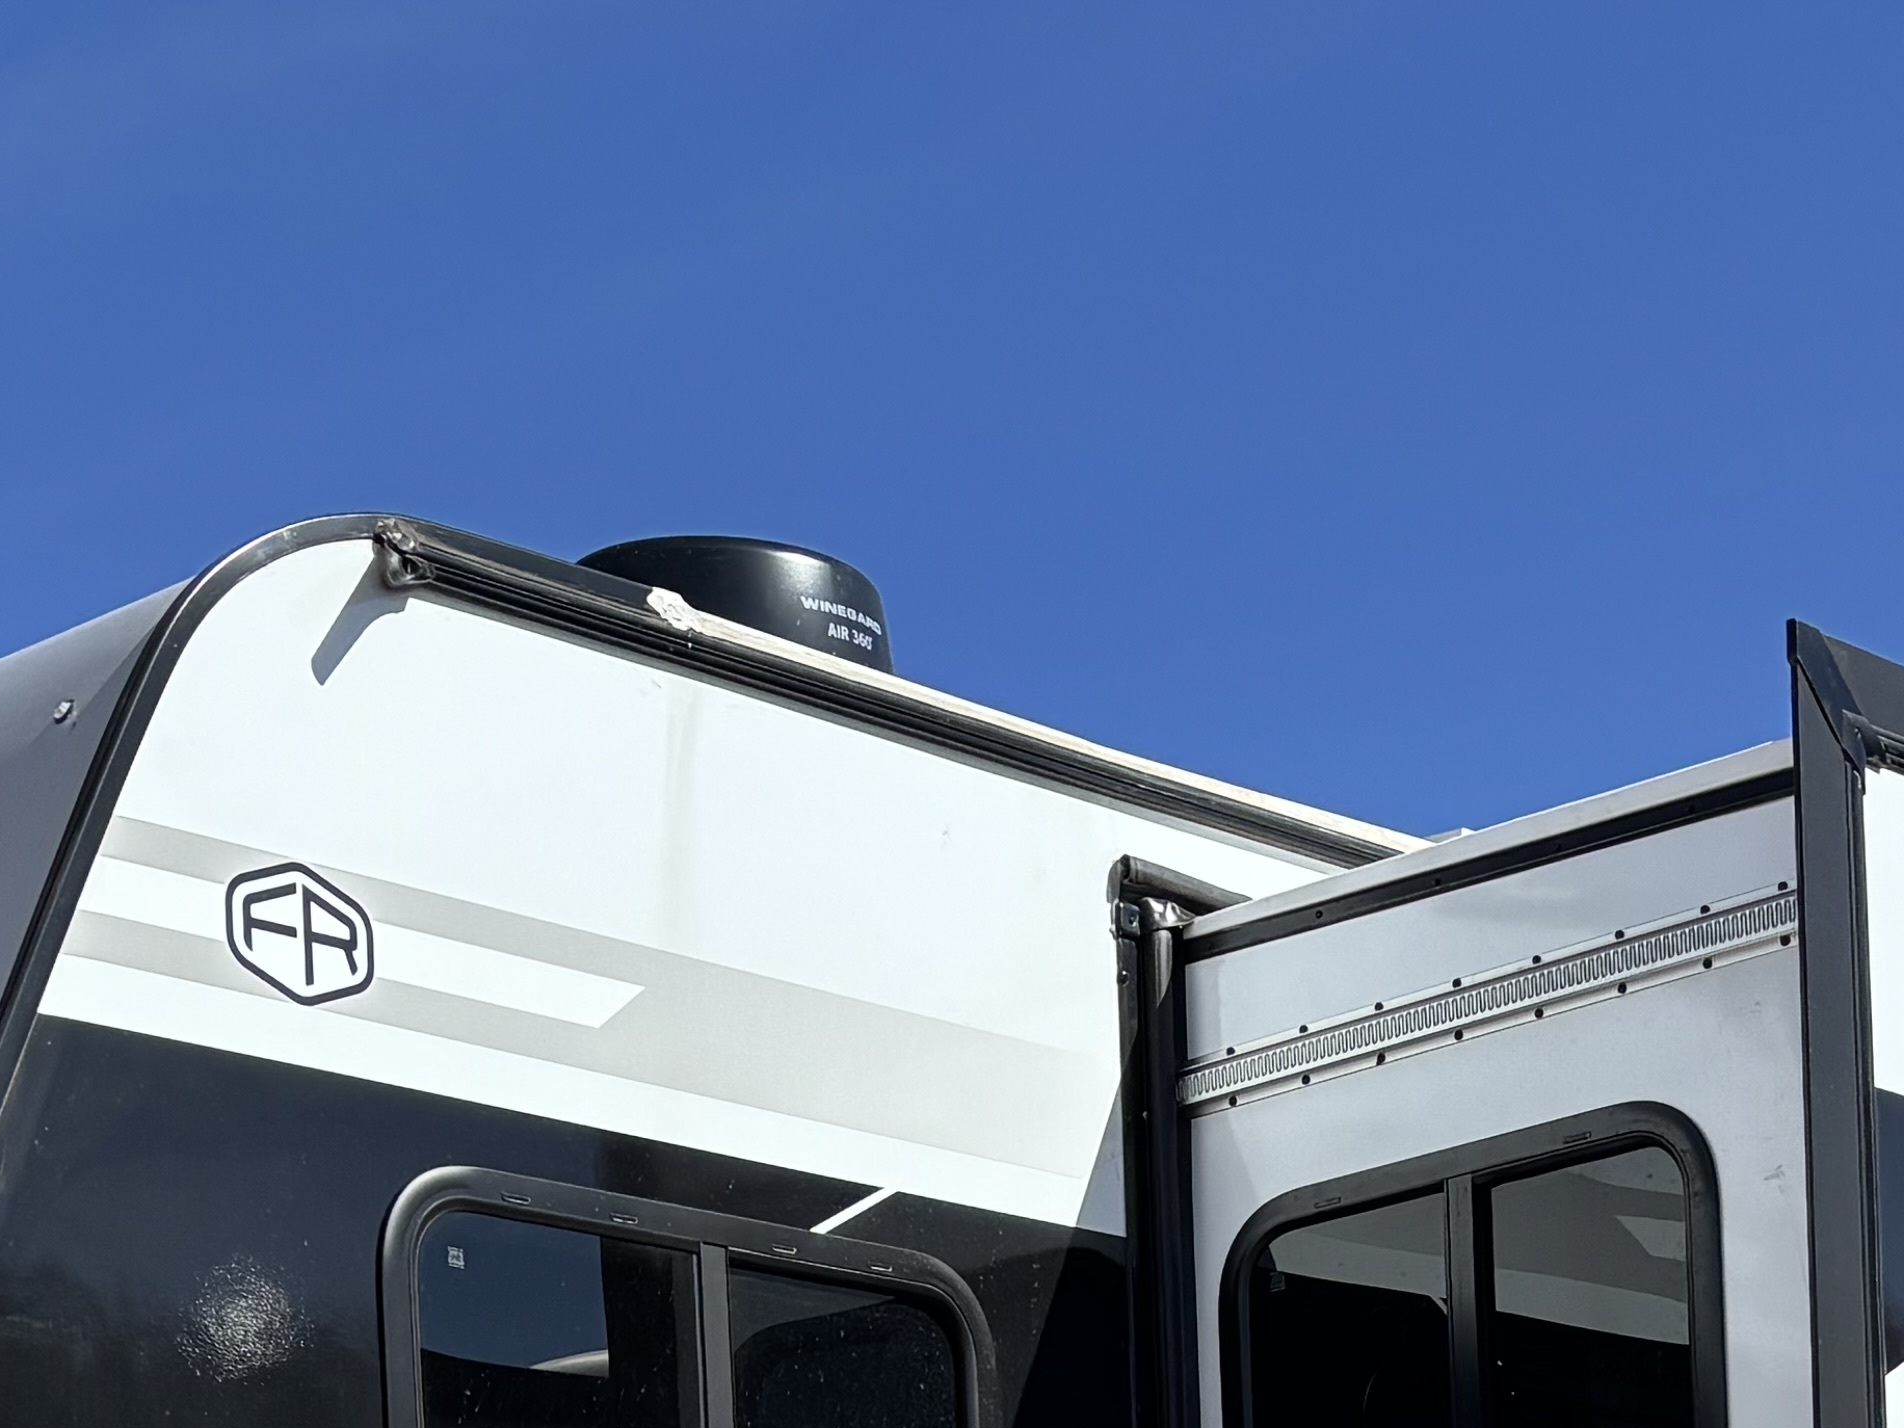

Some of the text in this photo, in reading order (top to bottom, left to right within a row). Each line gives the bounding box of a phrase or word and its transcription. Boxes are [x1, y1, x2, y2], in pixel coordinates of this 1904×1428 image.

[800, 595, 882, 635] WINEGARD
[827, 622, 850, 641] AIR
[242, 881, 359, 987] FR
